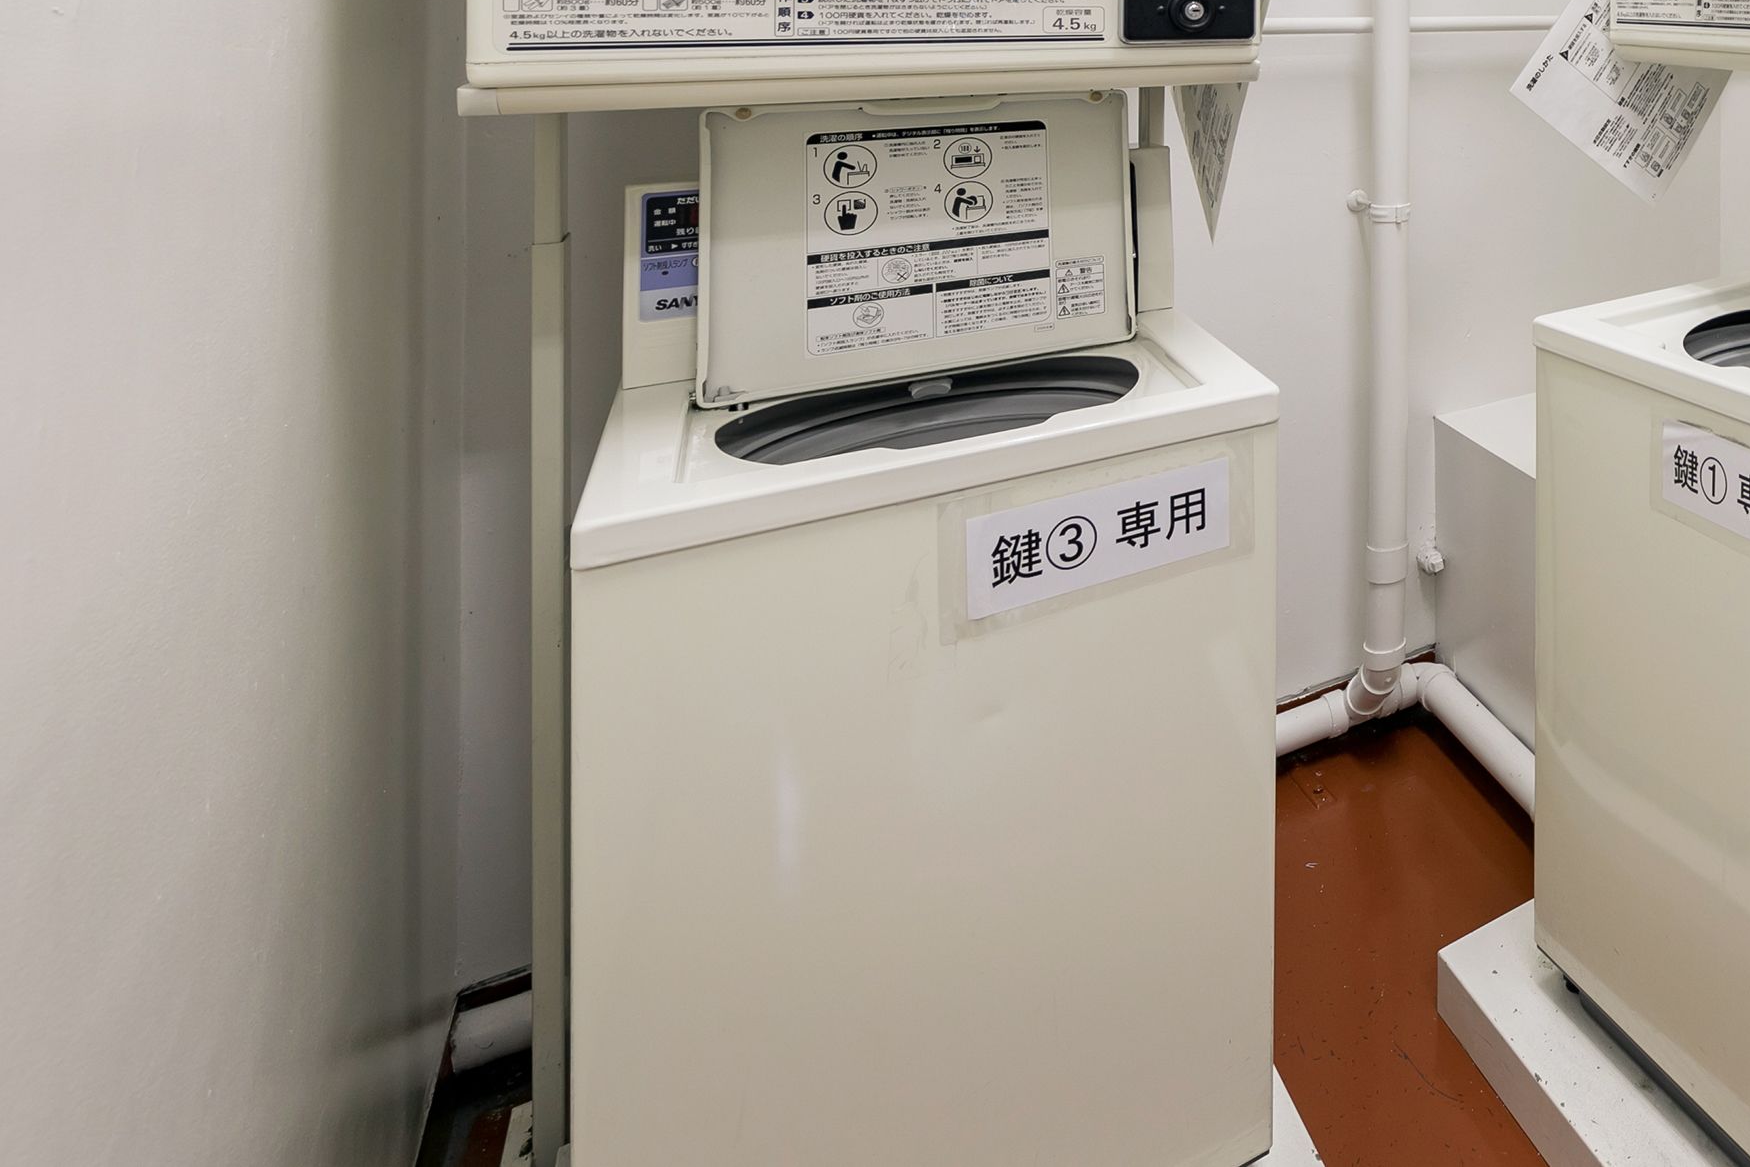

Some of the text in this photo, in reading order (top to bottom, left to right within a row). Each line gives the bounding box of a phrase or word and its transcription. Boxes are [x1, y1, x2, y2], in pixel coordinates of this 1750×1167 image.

[1052, 17, 1096, 32] 4.5 kg
[510, 29, 733, 40] 4.5kg以上の洗濯物を入れないでください。
[1526, 53, 1554, 91] 洗濯のしかた
[820, 133, 863, 142] 洗濯の順序
[933, 139, 941, 149] 2
[812, 147, 818, 157] 1
[934, 184, 942, 194] 4
[812, 194, 821, 205] 3
[820, 243, 930, 262] 硬貨を投入するときのご注意
[830, 289, 910, 305] ソフト剤のご使用方法
[1673, 444, 1728, 505] 鍵①
[991, 487, 1206, 588] 鍵③ 専用
